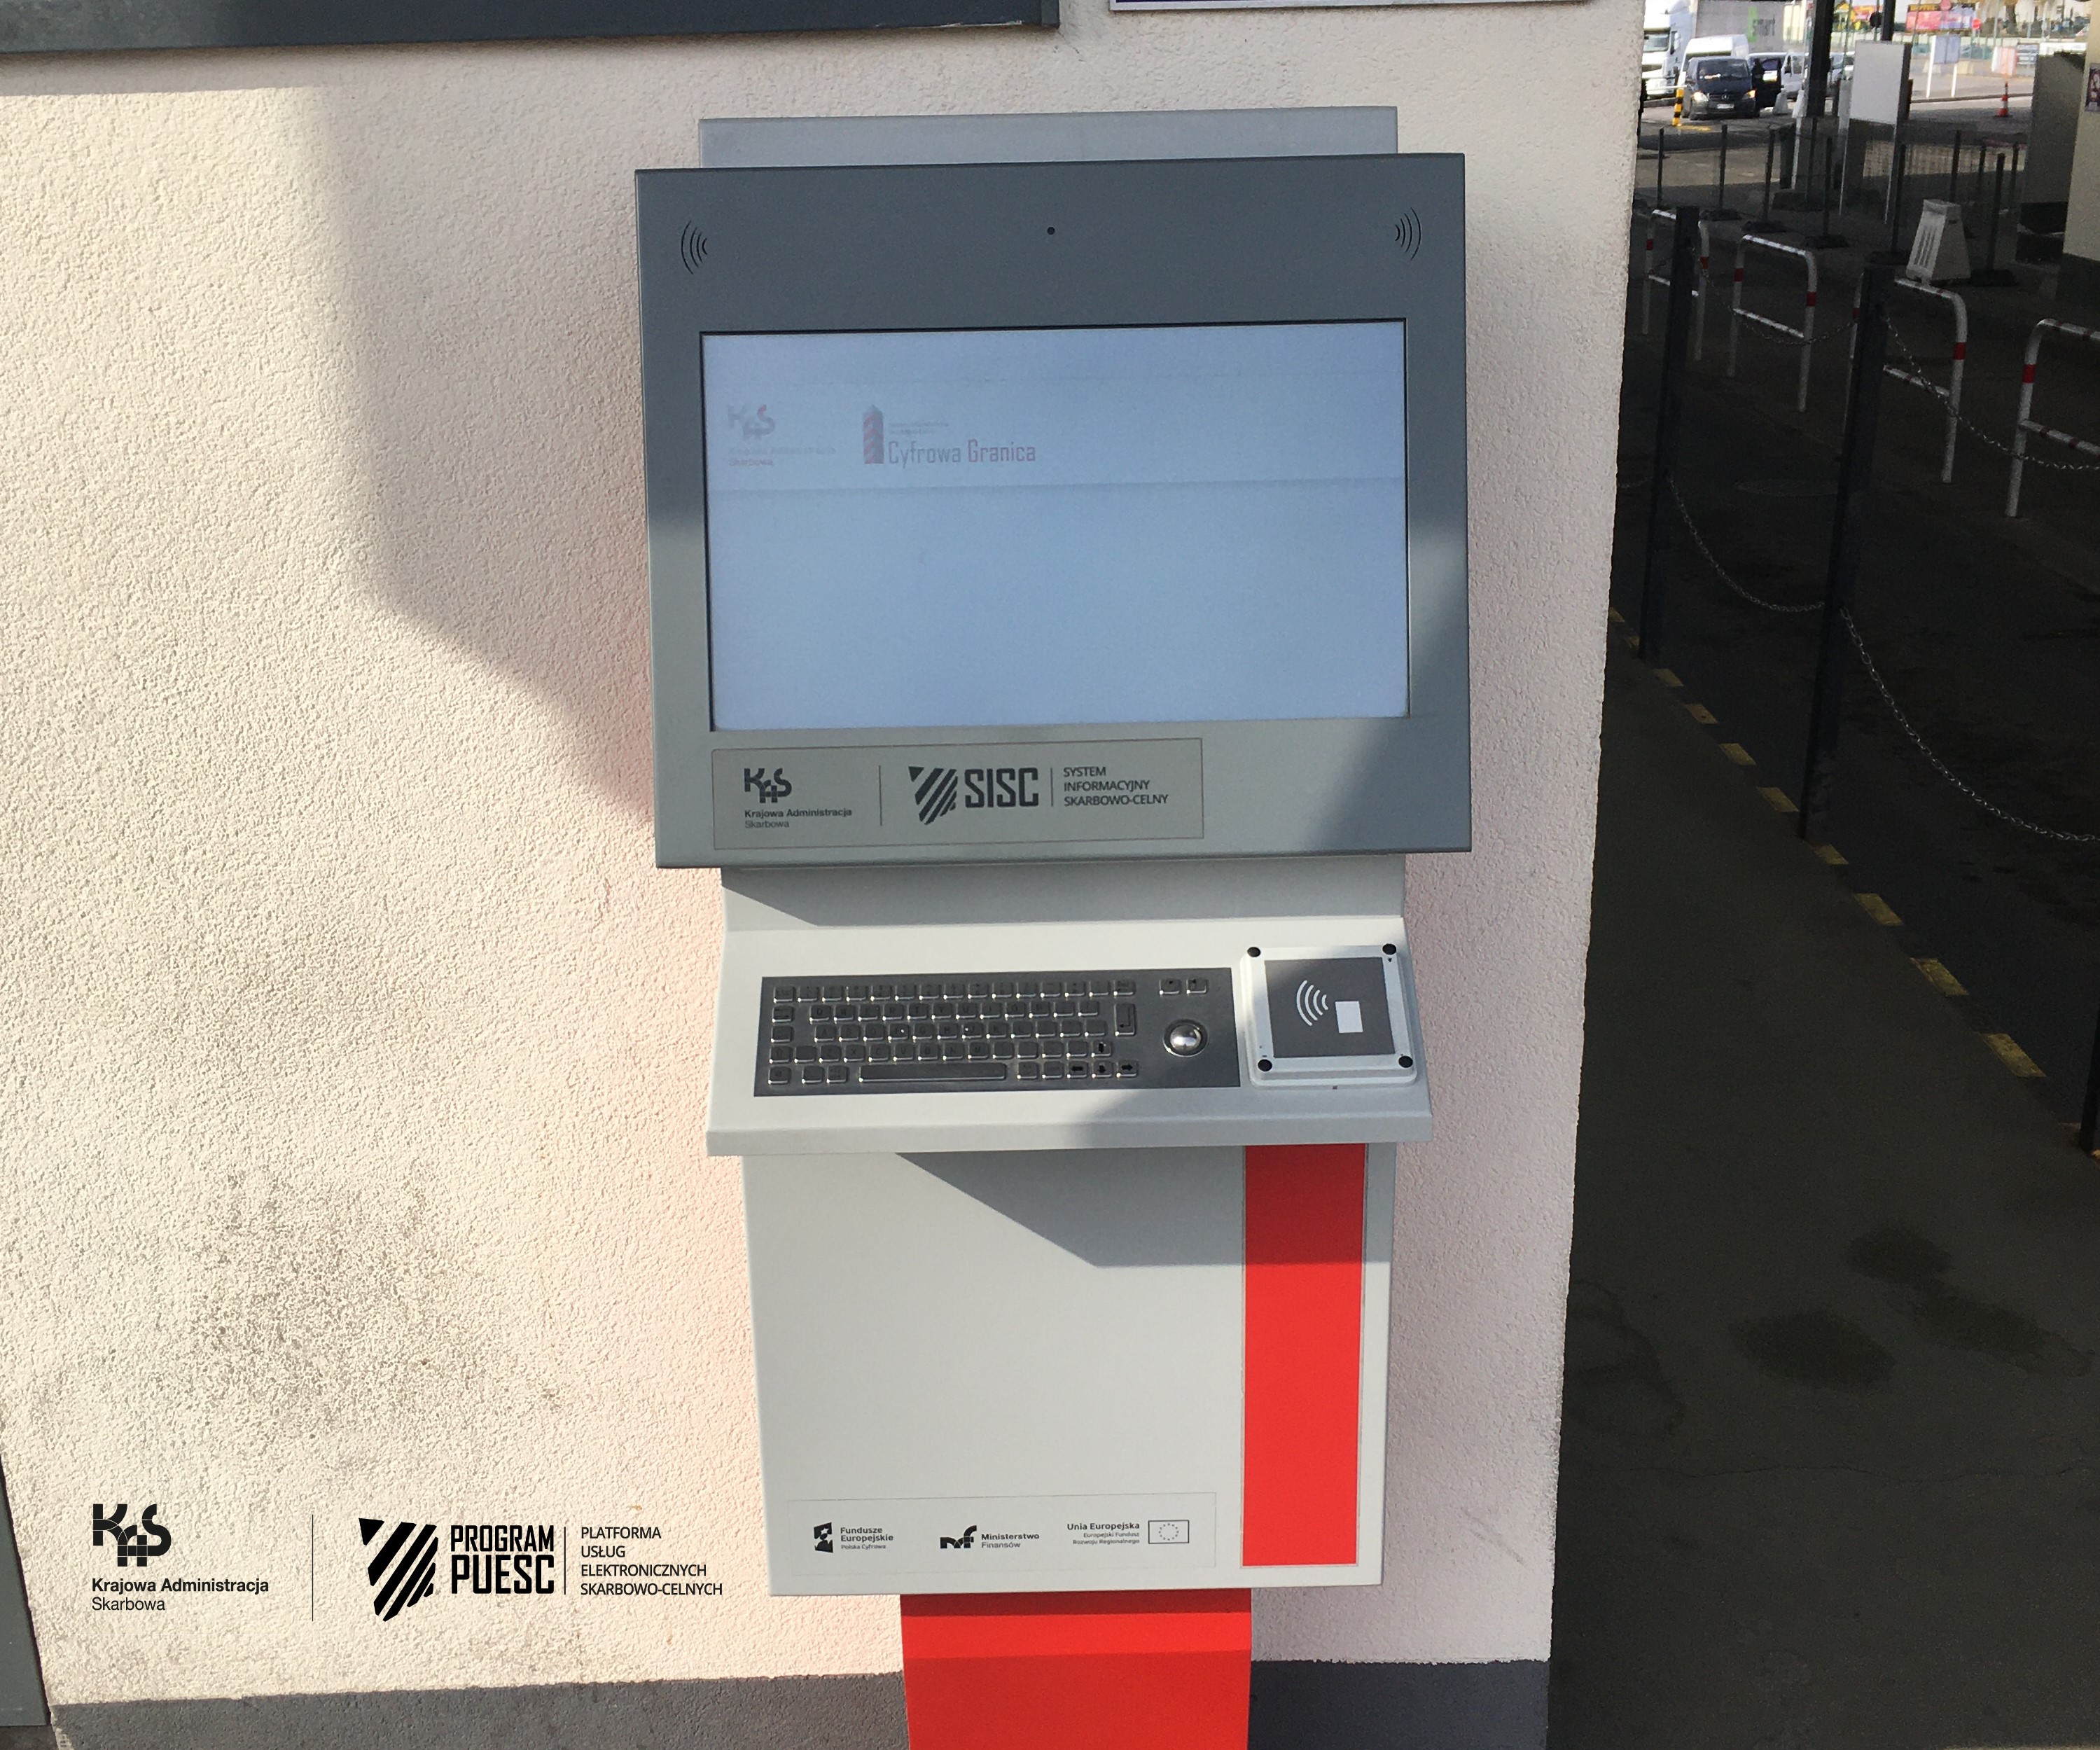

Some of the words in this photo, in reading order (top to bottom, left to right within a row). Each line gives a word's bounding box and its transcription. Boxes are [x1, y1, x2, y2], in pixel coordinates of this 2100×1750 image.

[888, 440, 961, 468] Cyfrowa
[967, 438, 1036, 463] Granica
[1063, 766, 1106, 778] SYSTEM
[964, 767, 1039, 809] SISC
[1064, 779, 1150, 793] INFORMACYJNY
[1064, 793, 1169, 807] SKARBOWO-CELNY
[744, 809, 784, 819] Krajowa
[786, 807, 852, 818] Administracja
[744, 817, 790, 829] Skarbowa
[1066, 1522, 1087, 1531] Unia
[1090, 1522, 1140, 1531] Europejska
[840, 1534, 893, 1543] Europejskie
